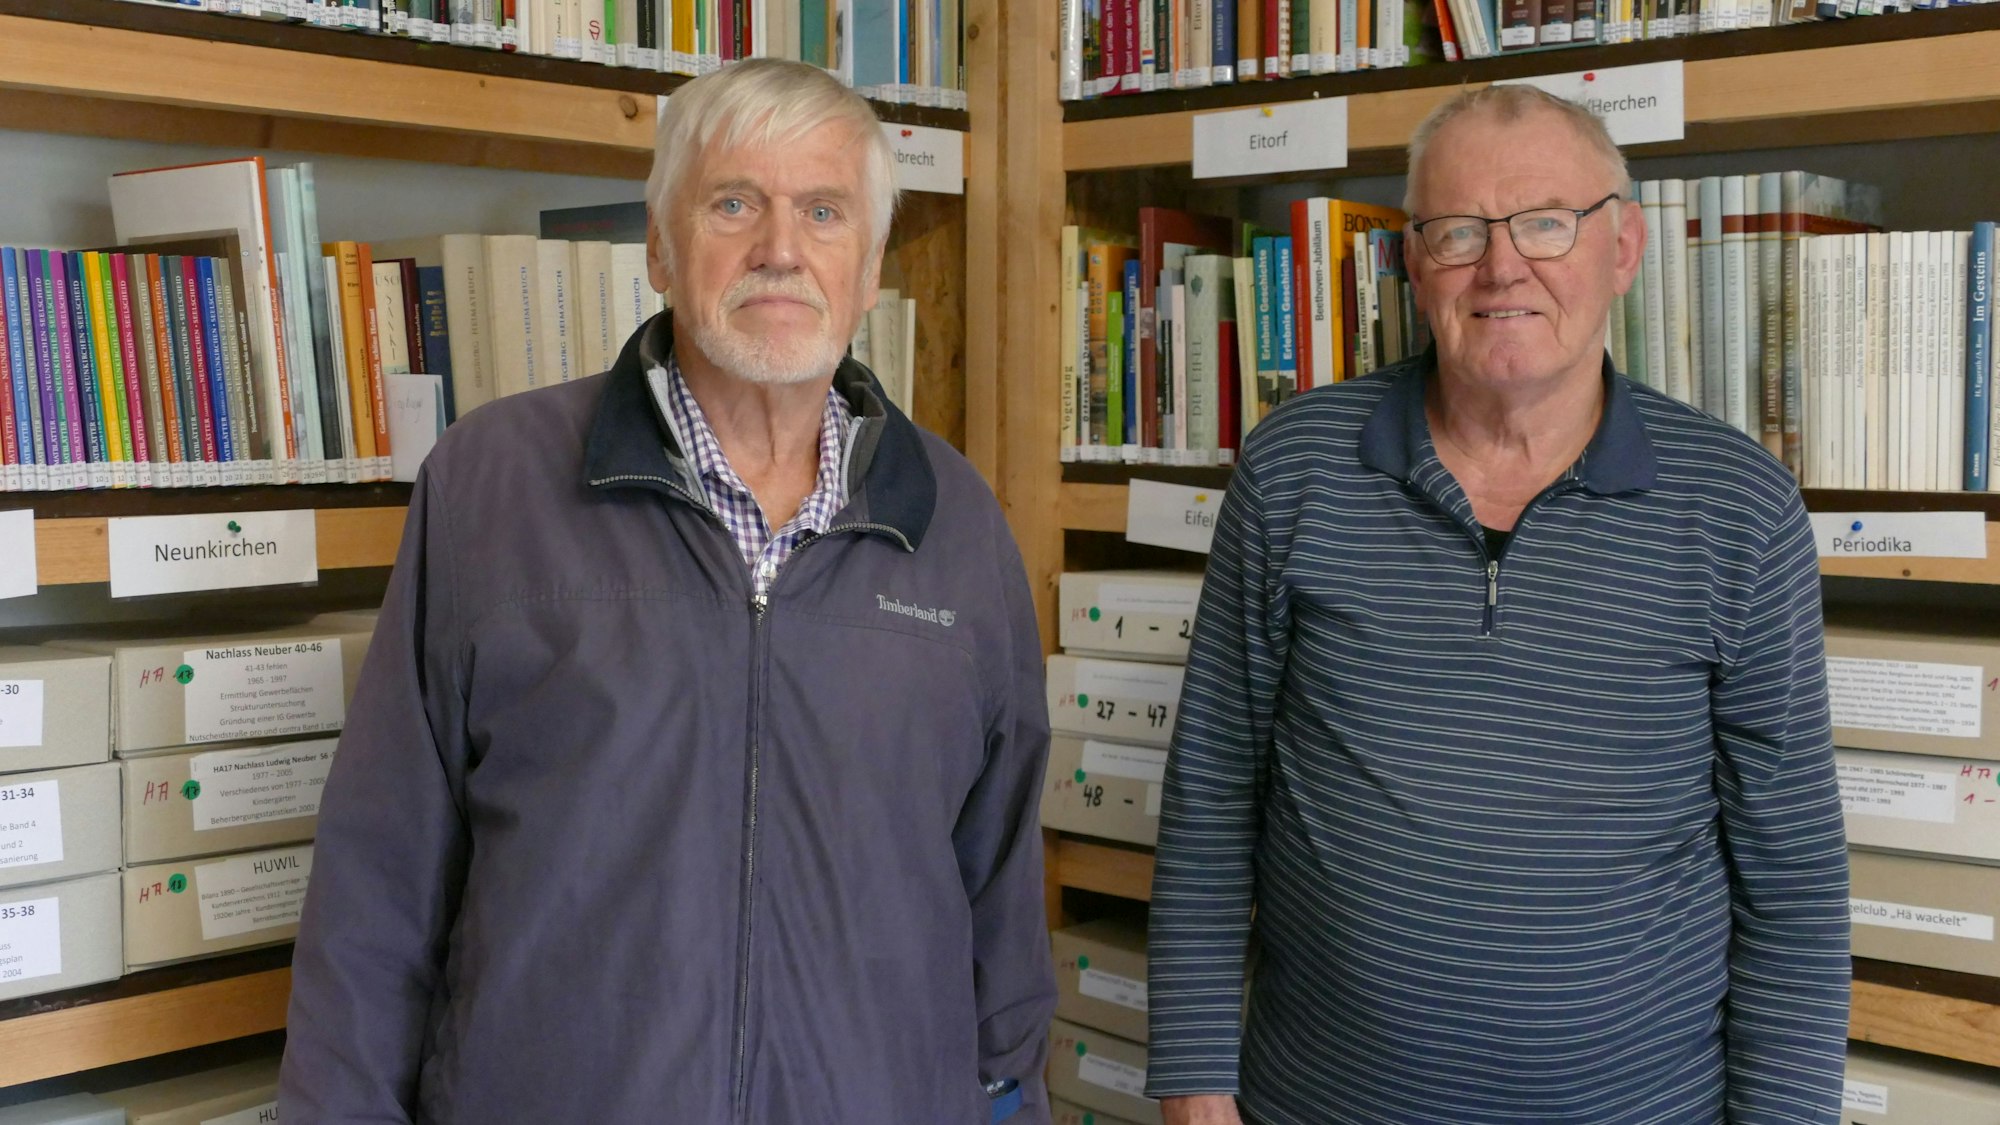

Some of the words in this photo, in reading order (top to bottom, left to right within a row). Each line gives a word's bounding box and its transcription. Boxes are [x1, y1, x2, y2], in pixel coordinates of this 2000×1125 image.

[1249, 131, 1288, 151] Eitorf
[895, 149, 935, 166] brecht
[1313, 220, 1325, 321] Beethoven-Jubiläum
[1973, 251, 1986, 302] Gesteins
[1258, 249, 1269, 313] Geschichte
[1280, 248, 1291, 312] Geschichte
[521, 266, 532, 335] HEIMATBUCH
[556, 270, 565, 337] HEIMATBUCH
[633, 278, 643, 328] NDENBUCH
[1973, 302, 1985, 322] Im
[1261, 314, 1271, 360] Erlebnis
[1282, 314, 1292, 360] Erlebnis
[1767, 347, 1776, 365] DES
[1785, 349, 1794, 367] DES
[1061, 366, 1073, 431] Vogelsang
[1768, 370, 1777, 418] JAHRBUCH
[1785, 370, 1795, 420] JAHRBUCH
[1185, 510, 1213, 528] Eifel
[155, 538, 277, 562] Neunkirchen
[1833, 537, 1911, 552] Periodika
[876, 594, 938, 623] Timberland
[1115, 616, 1123, 639] 1
[1179, 619, 1191, 640] 2
[206, 649, 251, 660] Nachlass
[254, 645, 292, 657] Neuber
[295, 642, 322, 654] 40-46
[266, 661, 288, 671] fehlen
[270, 675, 287, 683] 1997
[0, 684, 20, 695] -30
[220, 690, 258, 700] Ermittlung
[258, 686, 314, 697] Gewerbeflächen
[230, 699, 306, 712] Strukturuntersuchung
[1097, 701, 1115, 721] 27
[1147, 704, 1167, 728] 47
[220, 716, 256, 727] Gründung
[257, 715, 276, 723] einer
[286, 711, 316, 720] Gewerbe
[189, 729, 249, 742] Nutscheidstraße
[249, 730, 262, 739] pro
[263, 726, 278, 735] und
[279, 725, 302, 734] contra
[213, 764, 233, 773] HA17
[234, 761, 265, 770] Nachlass
[266, 757, 291, 768] Ludwig
[292, 754, 317, 763] Neuber
[1, 787, 35, 801] 31-34
[220, 785, 270, 798] Verschiedenes
[271, 784, 284, 792] von
[252, 794, 297, 806] Kindergärten
[1084, 784, 1104, 807] 48
[211, 806, 298, 824] Beherbergungsstatistiken
[9, 821, 29, 831] Band
[1, 841, 16, 850] und
[0, 853, 38, 865] sanierung
[254, 856, 300, 875] HUWIL
[1, 905, 35, 919] 35-38
[2, 968, 22, 978] 2004
